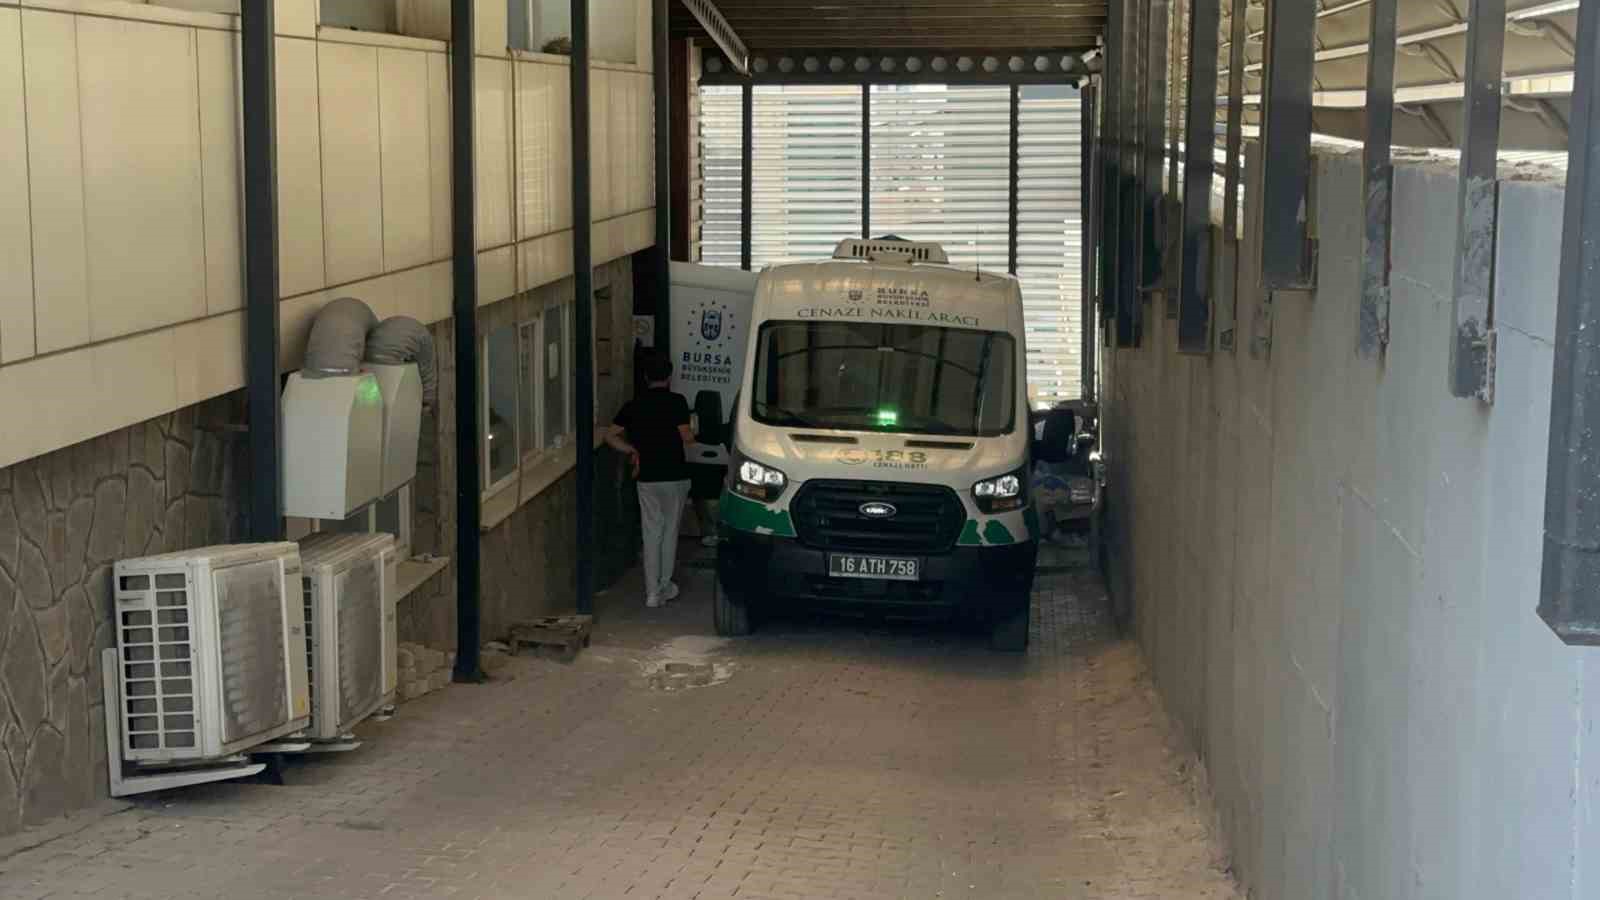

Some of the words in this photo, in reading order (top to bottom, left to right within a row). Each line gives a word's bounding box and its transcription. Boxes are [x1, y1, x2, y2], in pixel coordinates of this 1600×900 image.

[797, 307, 863, 318] CENAZE
[927, 312, 980, 327] ARACI
[682, 351, 732, 366] BURSA
[871, 449, 928, 464] 188
[840, 557, 855, 573] 16
[860, 558, 886, 574] ATH
[889, 560, 916, 576] 758
